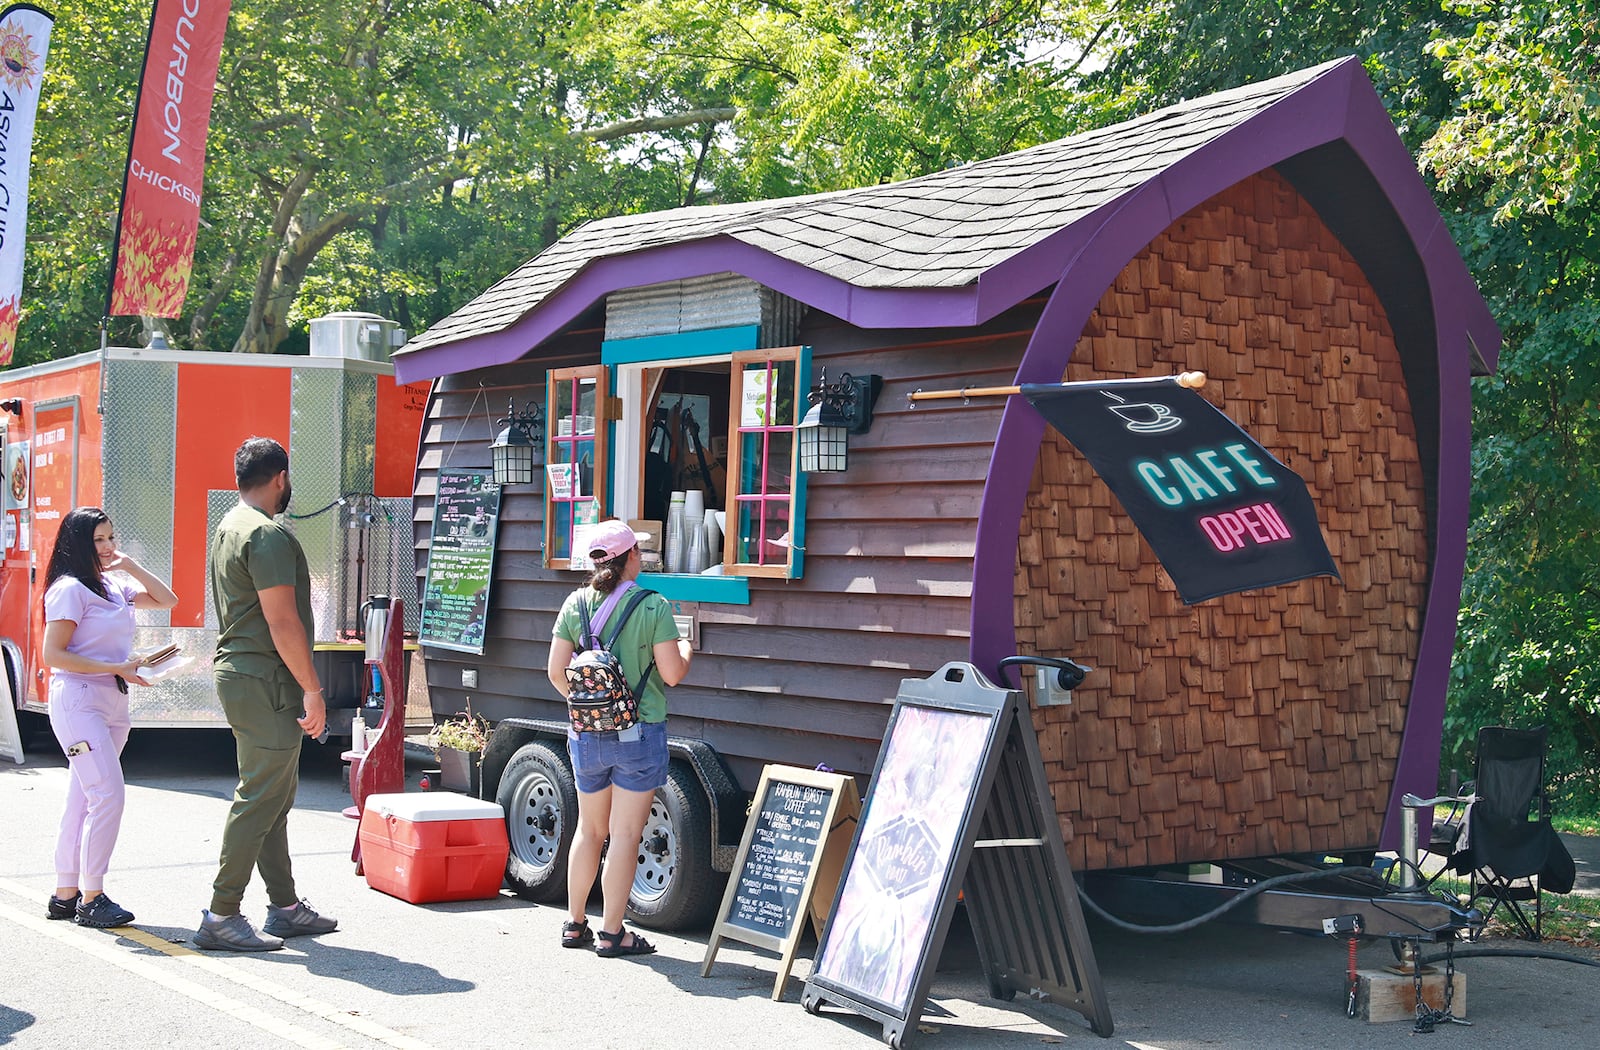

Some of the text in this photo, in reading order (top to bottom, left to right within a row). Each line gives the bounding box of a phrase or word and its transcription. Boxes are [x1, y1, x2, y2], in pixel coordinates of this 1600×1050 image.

[161, 0, 200, 165] OURBON
[130, 159, 201, 208] CHICKEN
[1137, 444, 1276, 506] CAFE
[1199, 502, 1291, 553] OPEN
[784, 798, 808, 814] COFFEE
[803, 787, 826, 805] ROAST
[876, 833, 933, 876] Ramblin'
